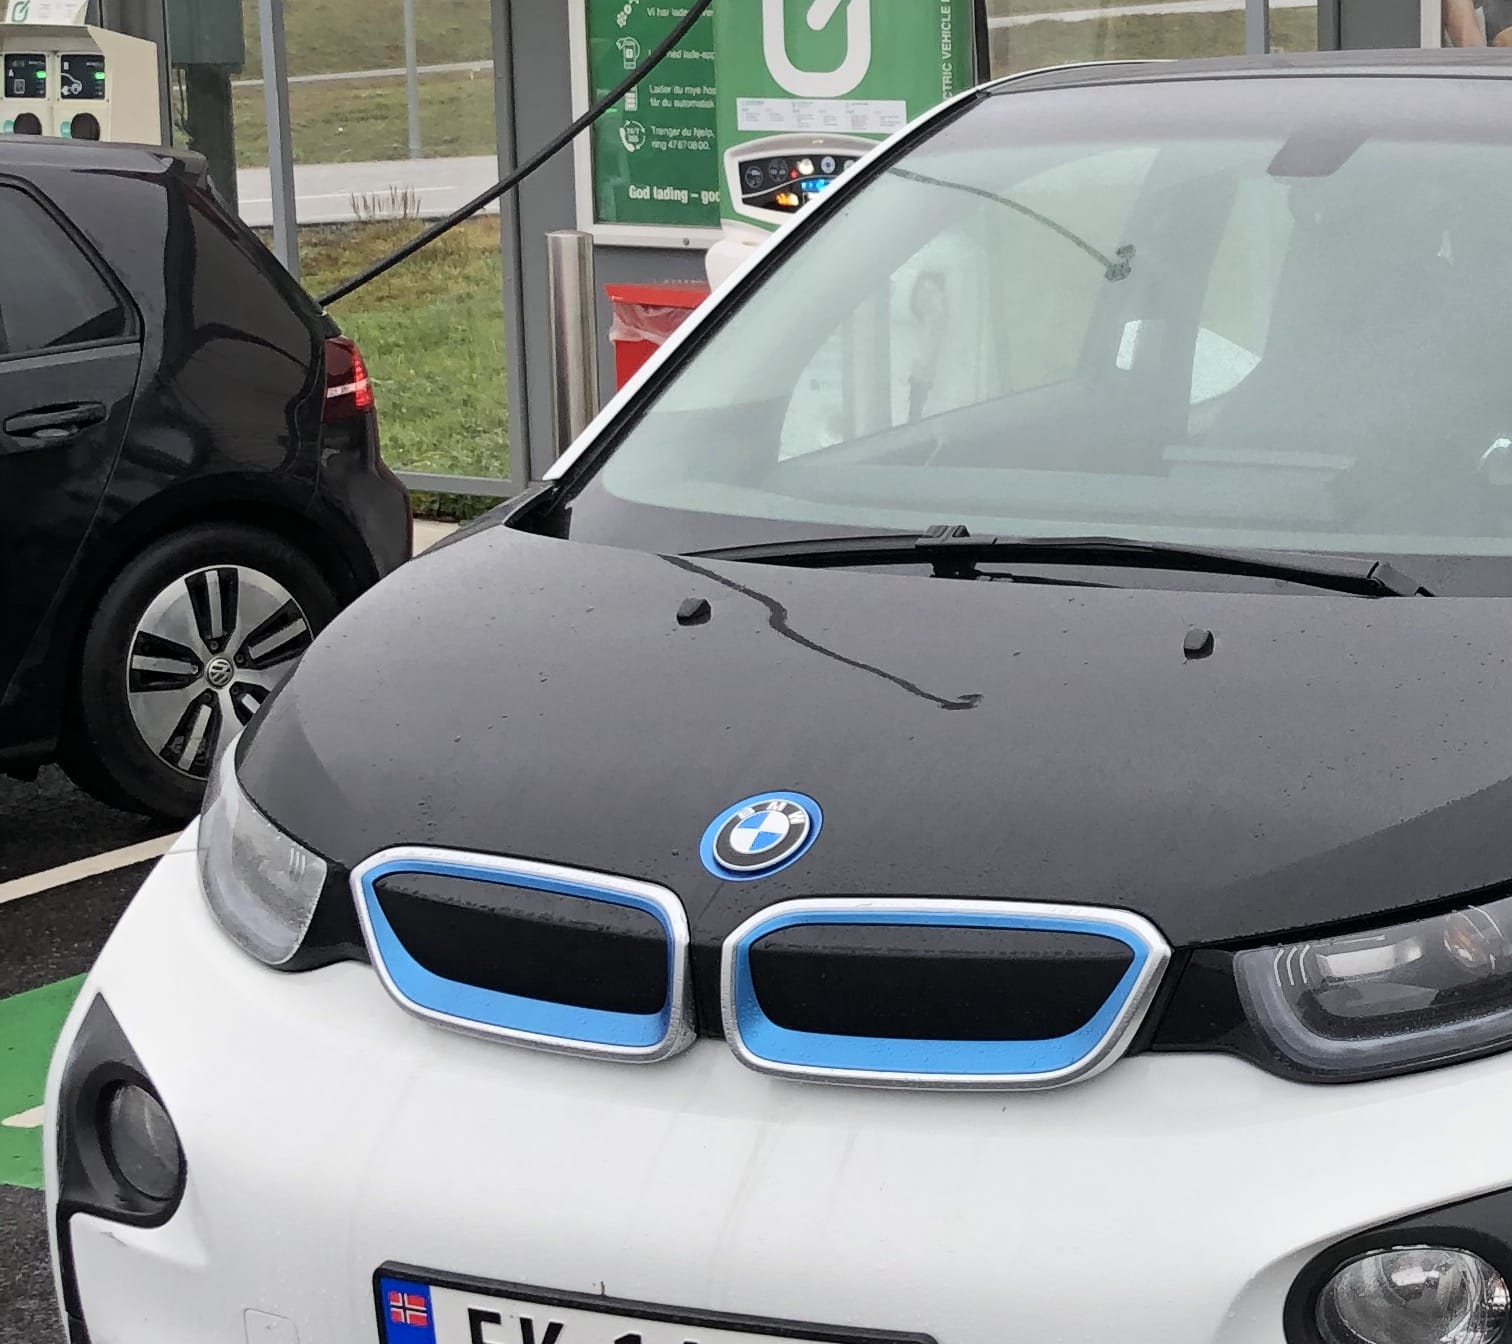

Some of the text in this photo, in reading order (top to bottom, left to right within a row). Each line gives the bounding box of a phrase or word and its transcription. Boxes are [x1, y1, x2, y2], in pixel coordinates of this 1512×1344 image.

[940, 6, 952, 60] VEHICLE
[681, 127, 692, 137] du
[629, 185, 650, 200] God
[653, 186, 688, 204] lading
